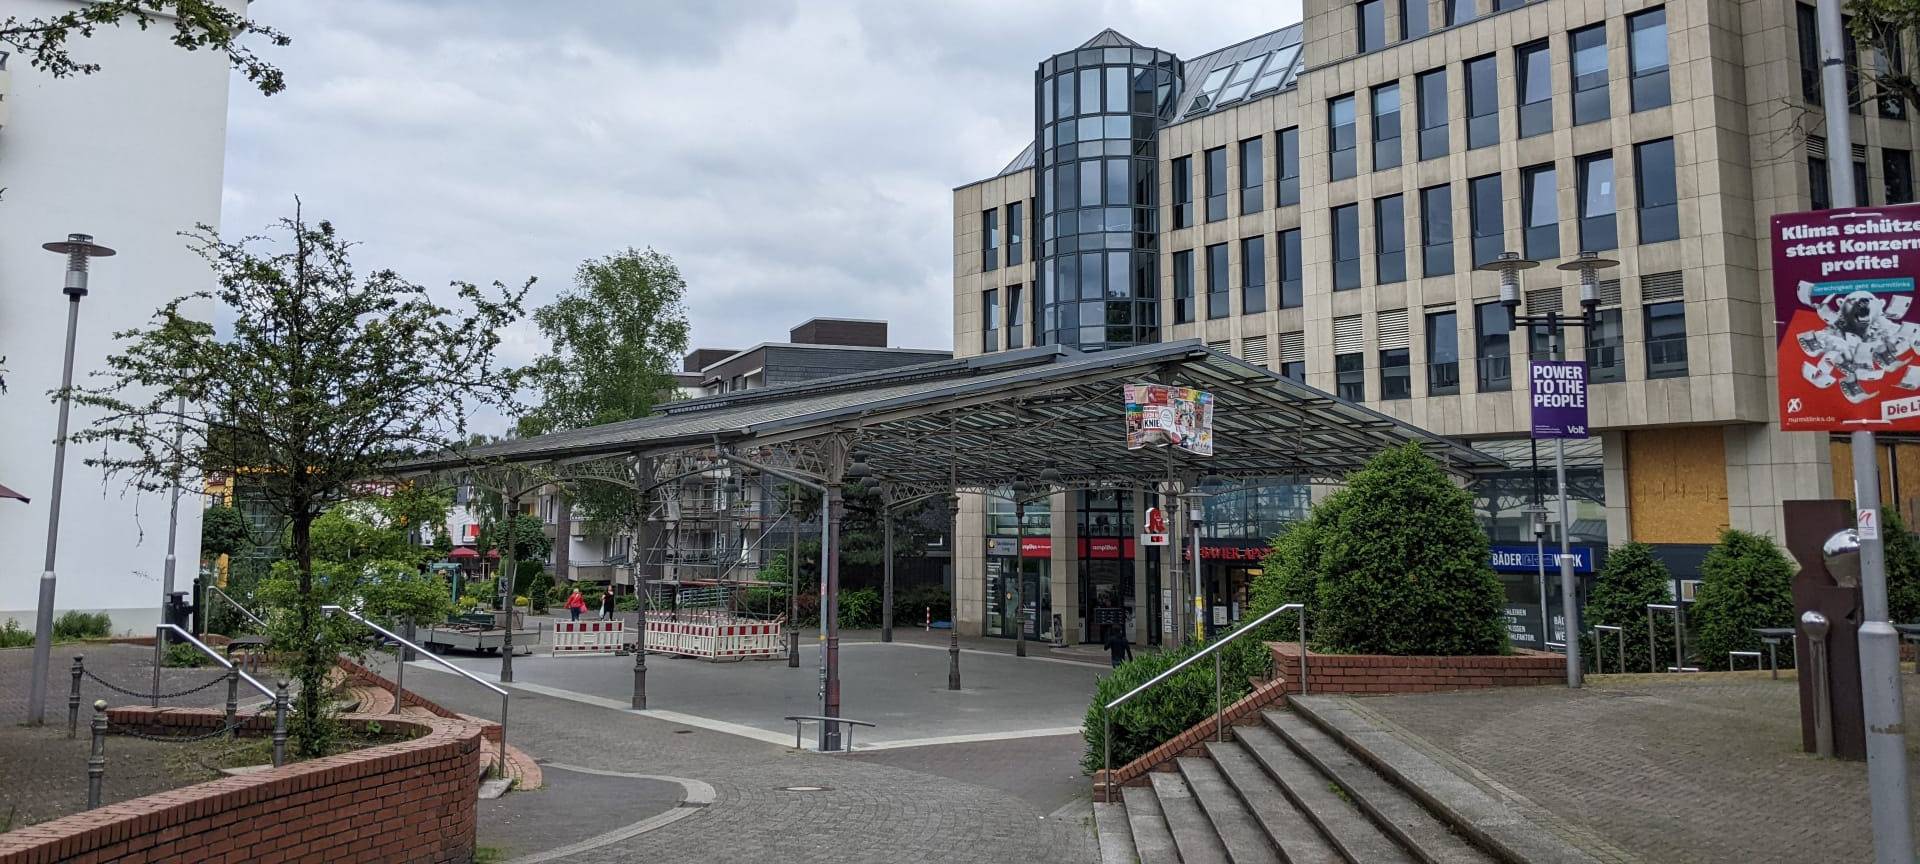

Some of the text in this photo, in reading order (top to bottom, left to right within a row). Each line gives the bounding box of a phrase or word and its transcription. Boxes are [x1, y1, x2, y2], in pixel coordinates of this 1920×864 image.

[1782, 225, 1839, 240] Klima
[1786, 241, 1836, 257] statt
[1821, 255, 1899, 276] profite!
[1533, 365, 1583, 379] POWER
[1534, 380, 1584, 394] TO THE
[1534, 394, 1585, 408] PEOPLE
[1887, 403, 1908, 415] Die
[1788, 415, 1835, 423] nurmitlinks.de
[1567, 425, 1585, 434] Volt
[1492, 550, 1522, 566] BÄDER
[1553, 553, 1583, 567] WRK
